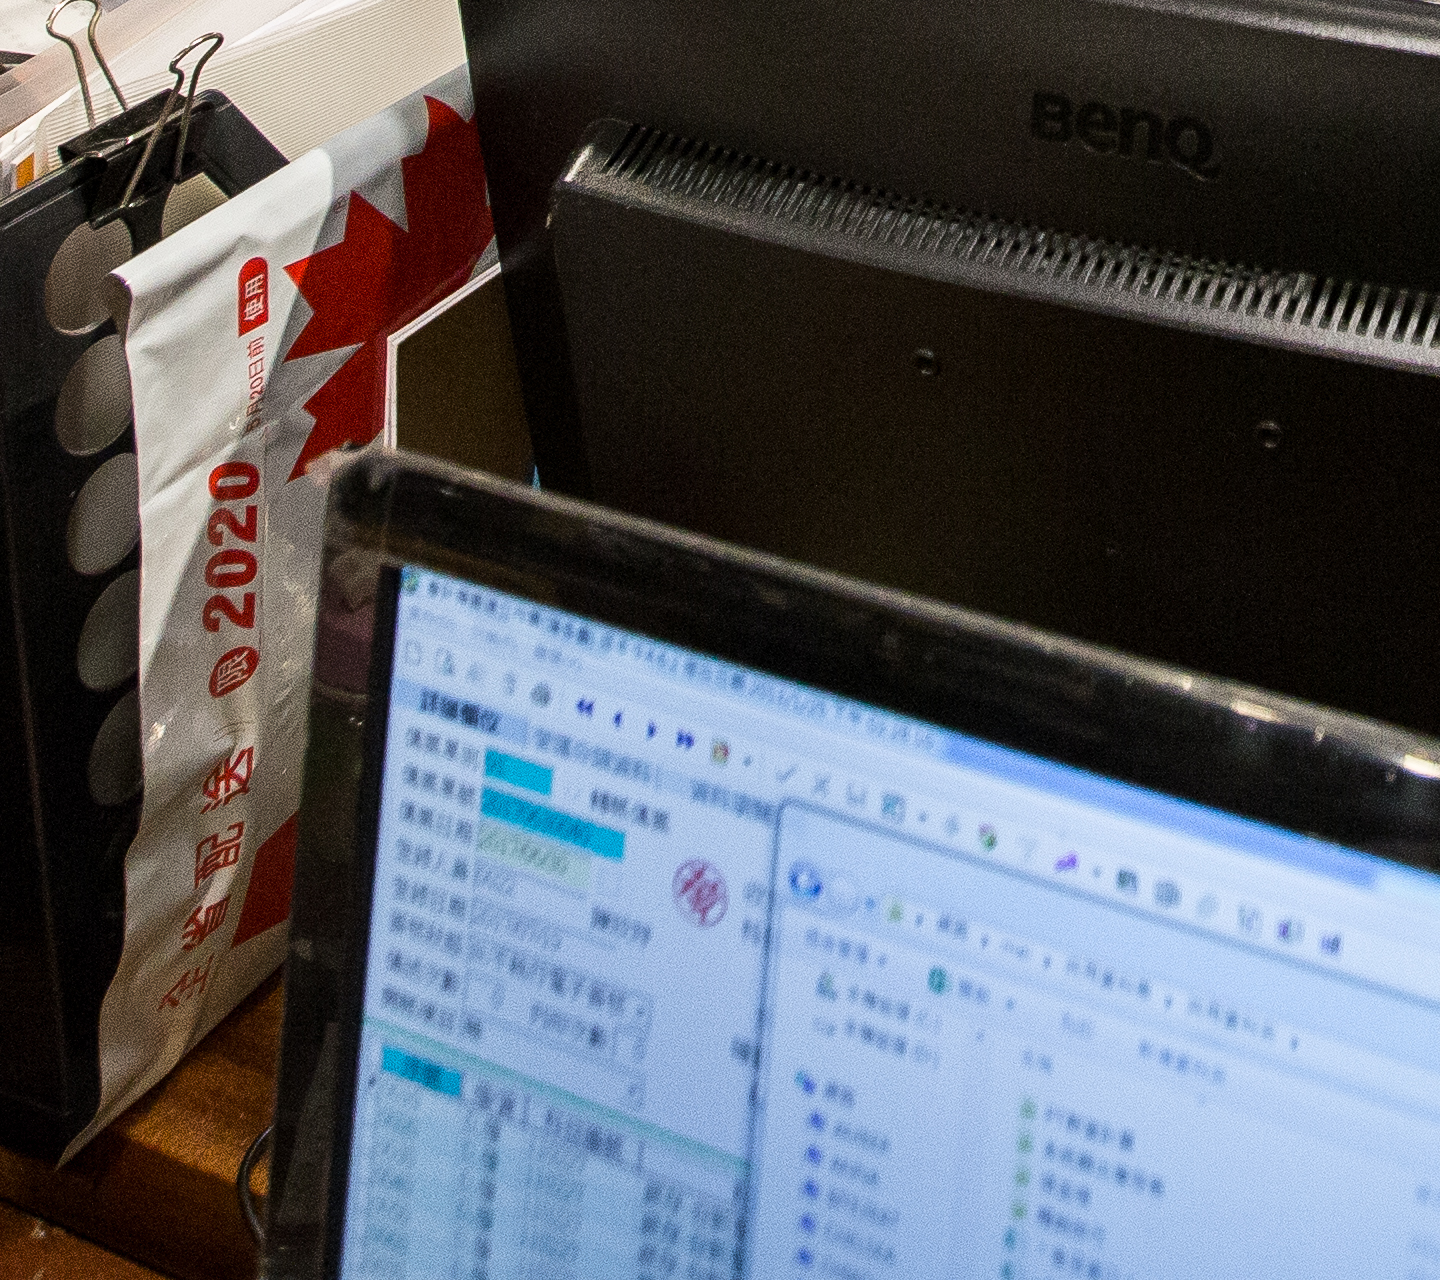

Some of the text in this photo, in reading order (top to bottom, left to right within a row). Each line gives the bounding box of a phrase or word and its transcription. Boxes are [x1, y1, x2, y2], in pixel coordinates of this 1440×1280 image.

[1030, 90, 1222, 183] BenQ
[244, 273, 265, 322] 使用
[203, 461, 260, 633] 2020
[213, 651, 256, 691] 限
[157, 746, 257, 1010] 全省配送
